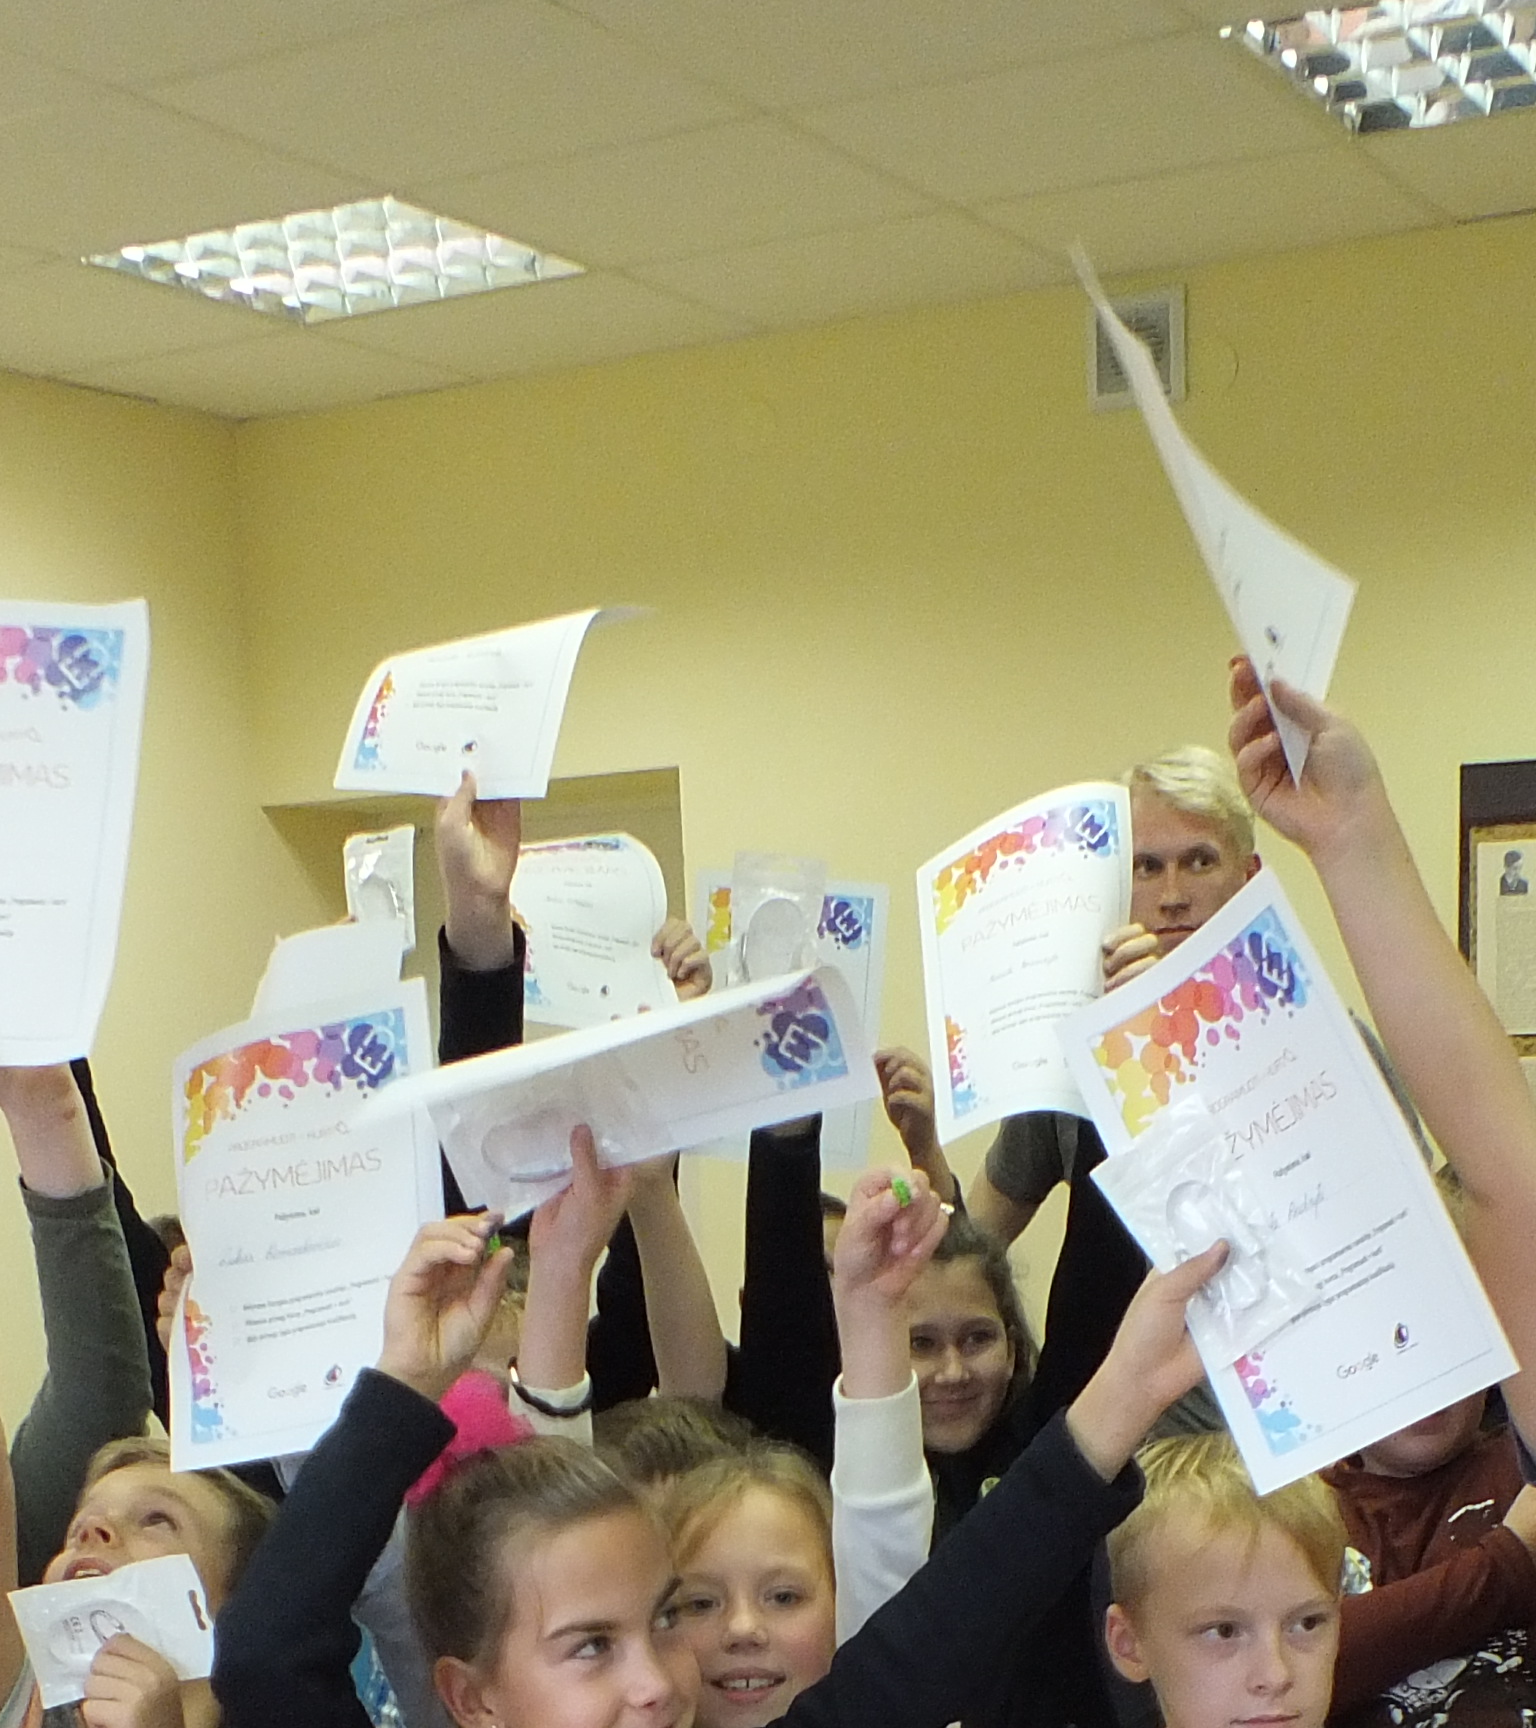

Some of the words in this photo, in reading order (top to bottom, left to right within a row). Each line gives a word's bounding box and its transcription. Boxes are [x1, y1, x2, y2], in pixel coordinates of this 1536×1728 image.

[1224, 1069, 1338, 1161] ŽYMĖJIMAS
[204, 1148, 383, 1201] PAŽYMĖJIMAS
[1336, 1352, 1380, 1380] Google
